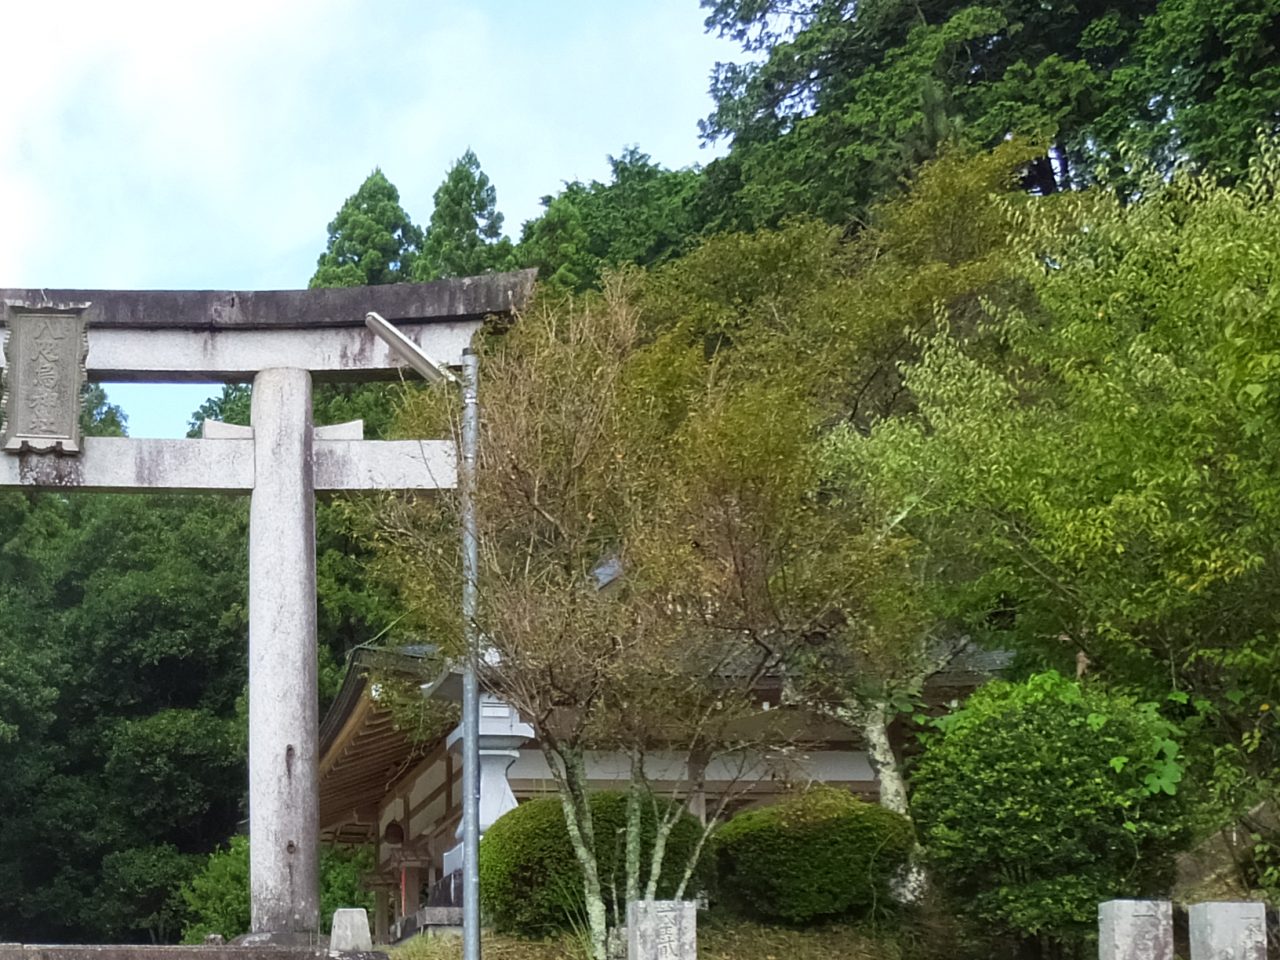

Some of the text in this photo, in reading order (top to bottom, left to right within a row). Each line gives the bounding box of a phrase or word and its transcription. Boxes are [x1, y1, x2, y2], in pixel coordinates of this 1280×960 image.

[30, 318, 66, 434] 八咫烏神社
